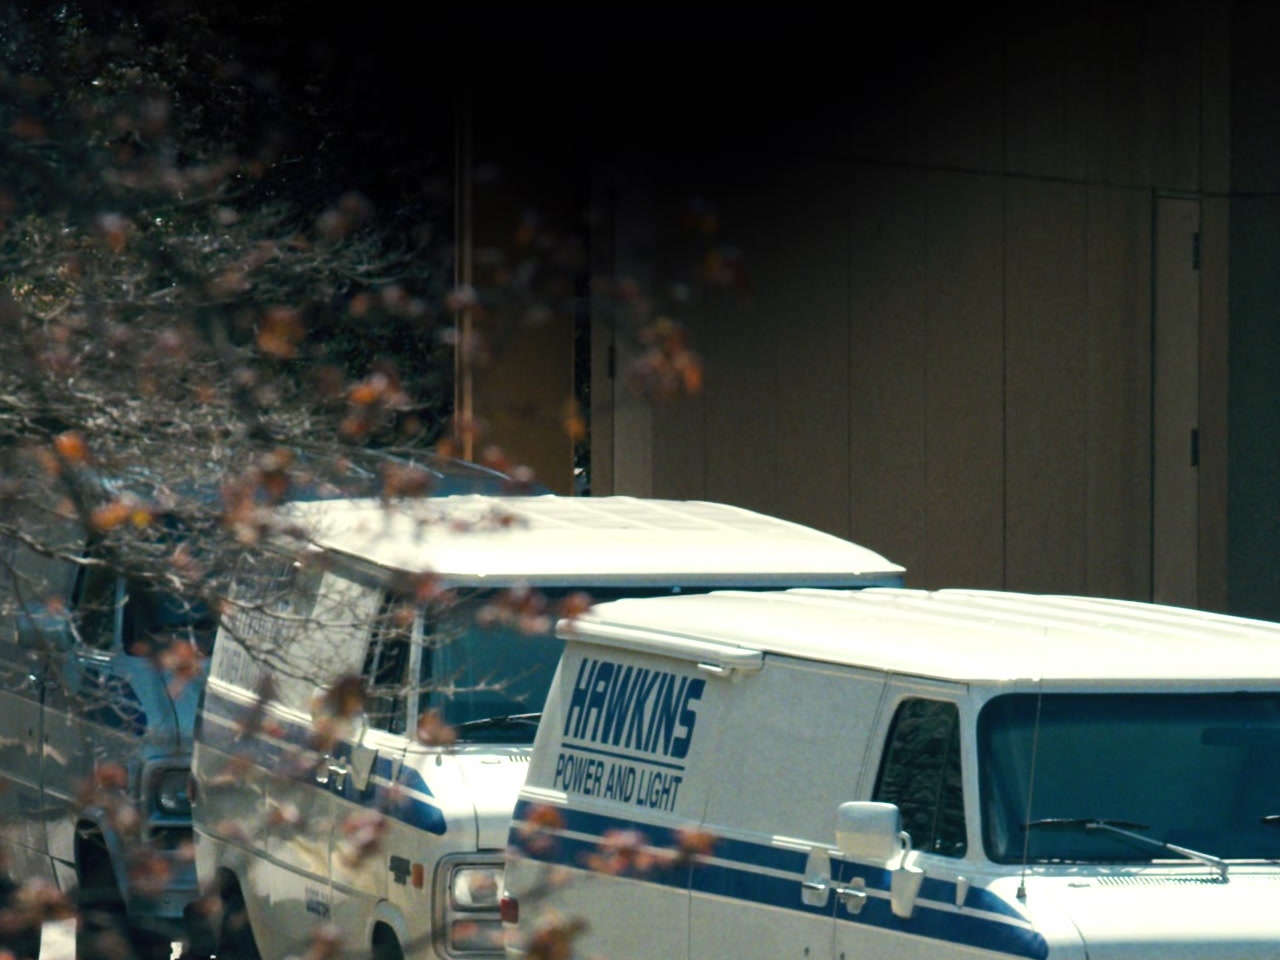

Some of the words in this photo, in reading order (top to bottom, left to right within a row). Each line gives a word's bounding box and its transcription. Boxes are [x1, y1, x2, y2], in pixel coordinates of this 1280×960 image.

[564, 657, 706, 759] HAWKINS
[554, 753, 604, 796] POWER
[604, 763, 636, 803] AND
[637, 770, 683, 812] LIGHT
